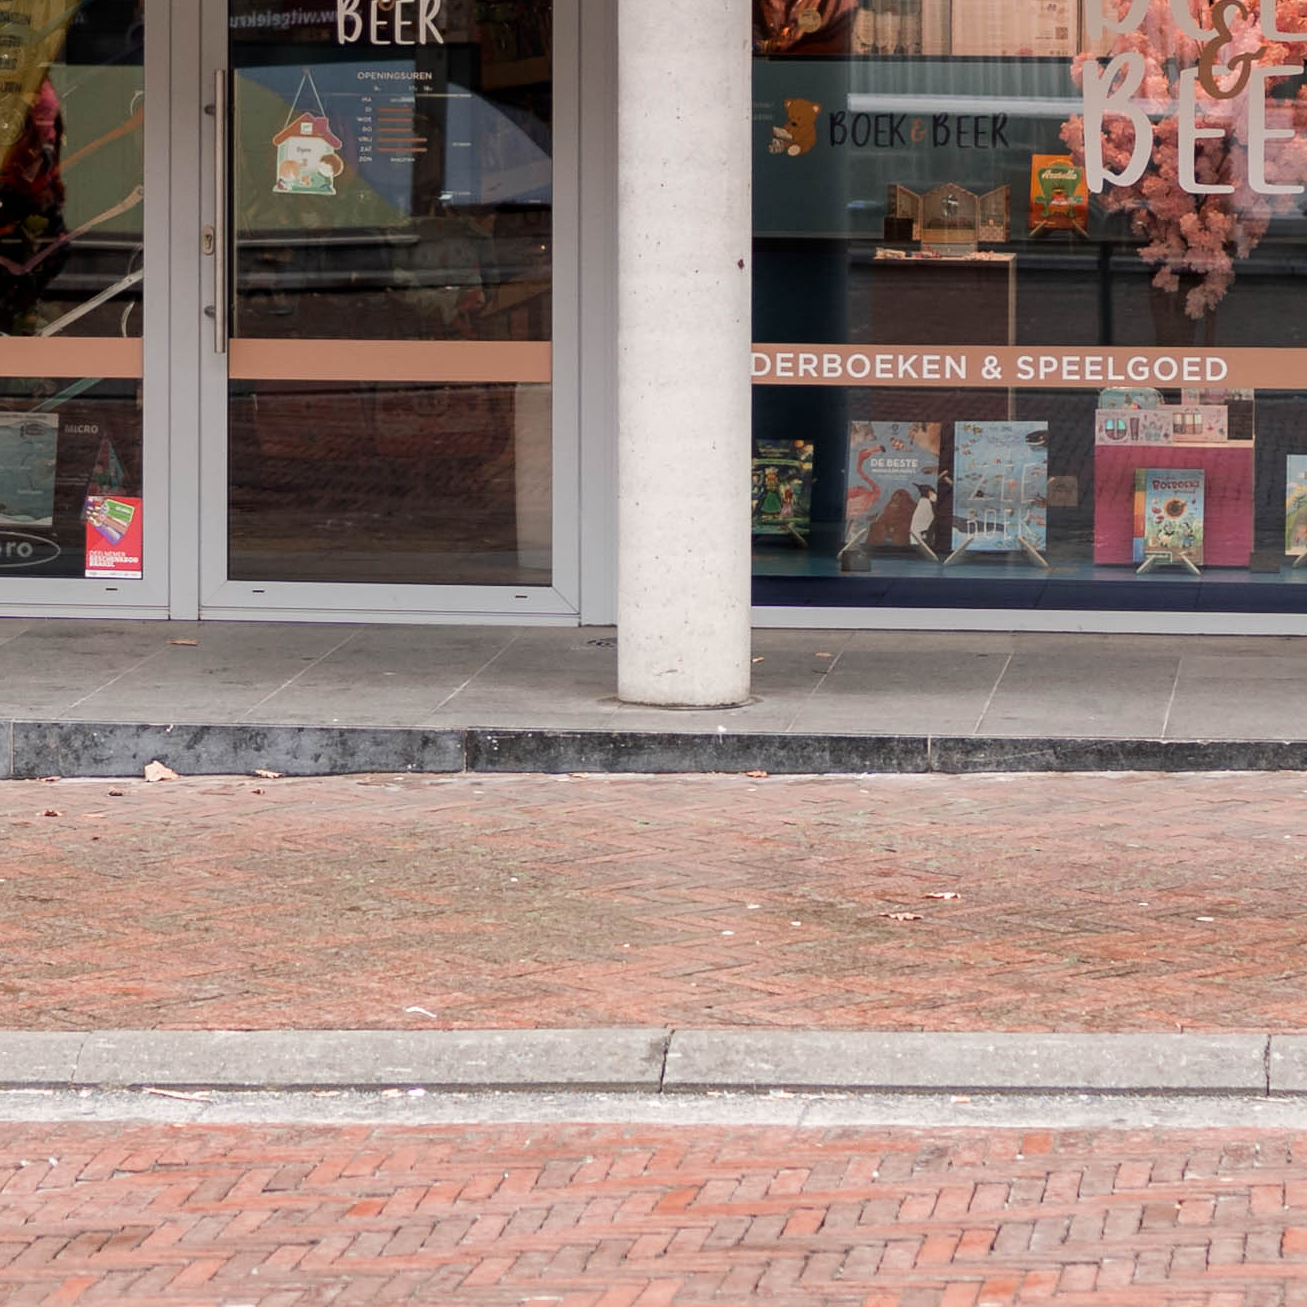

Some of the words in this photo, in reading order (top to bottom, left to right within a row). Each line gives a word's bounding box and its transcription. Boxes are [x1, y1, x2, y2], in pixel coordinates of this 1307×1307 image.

[357, 71, 433, 81] OPENINGSUREN
[830, 110, 907, 148] BOEK
[933, 111, 1010, 149] BEER
[751, 352, 967, 380] DERBOEKEN
[981, 356, 1002, 379] &
[1016, 356, 1228, 382] SPEELGOED
[886, 458, 918, 468] BESTE
